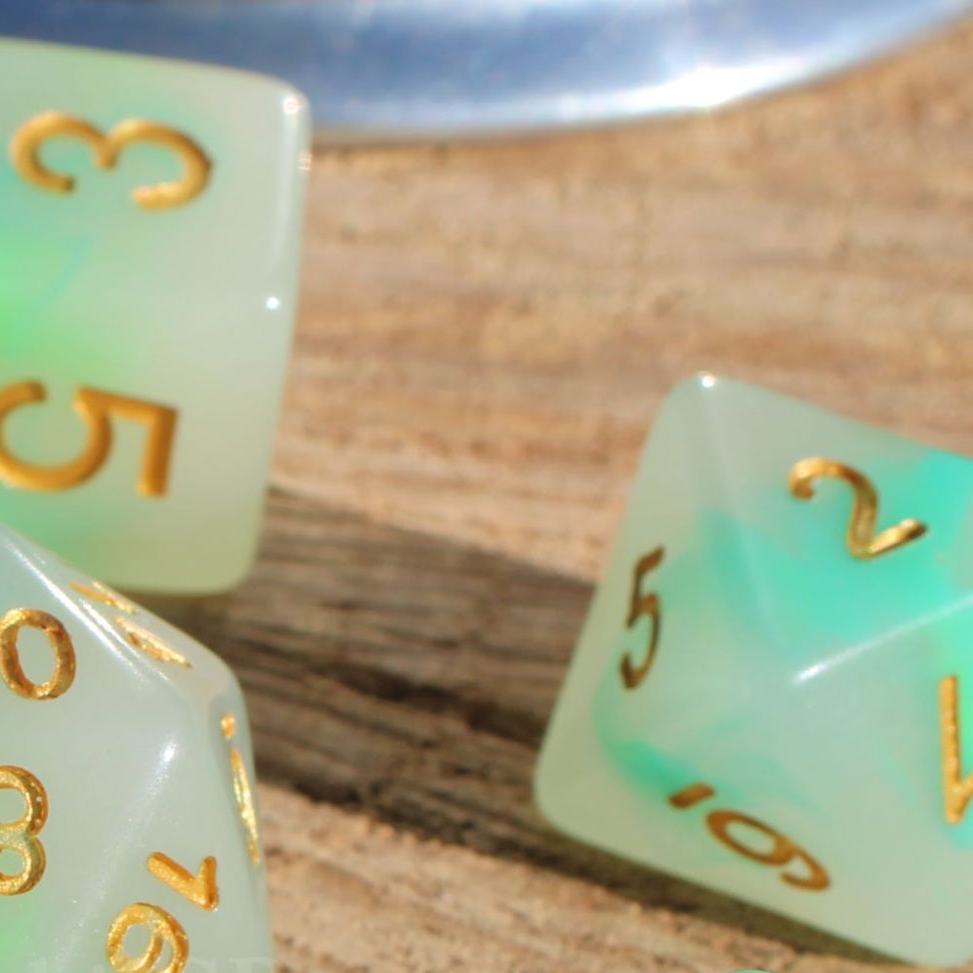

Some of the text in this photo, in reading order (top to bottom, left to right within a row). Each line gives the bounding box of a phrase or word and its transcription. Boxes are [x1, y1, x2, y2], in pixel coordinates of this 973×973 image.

[9, 110, 213, 212] 3
[789, 457, 927, 560] 2
[620, 546, 665, 692] 5
